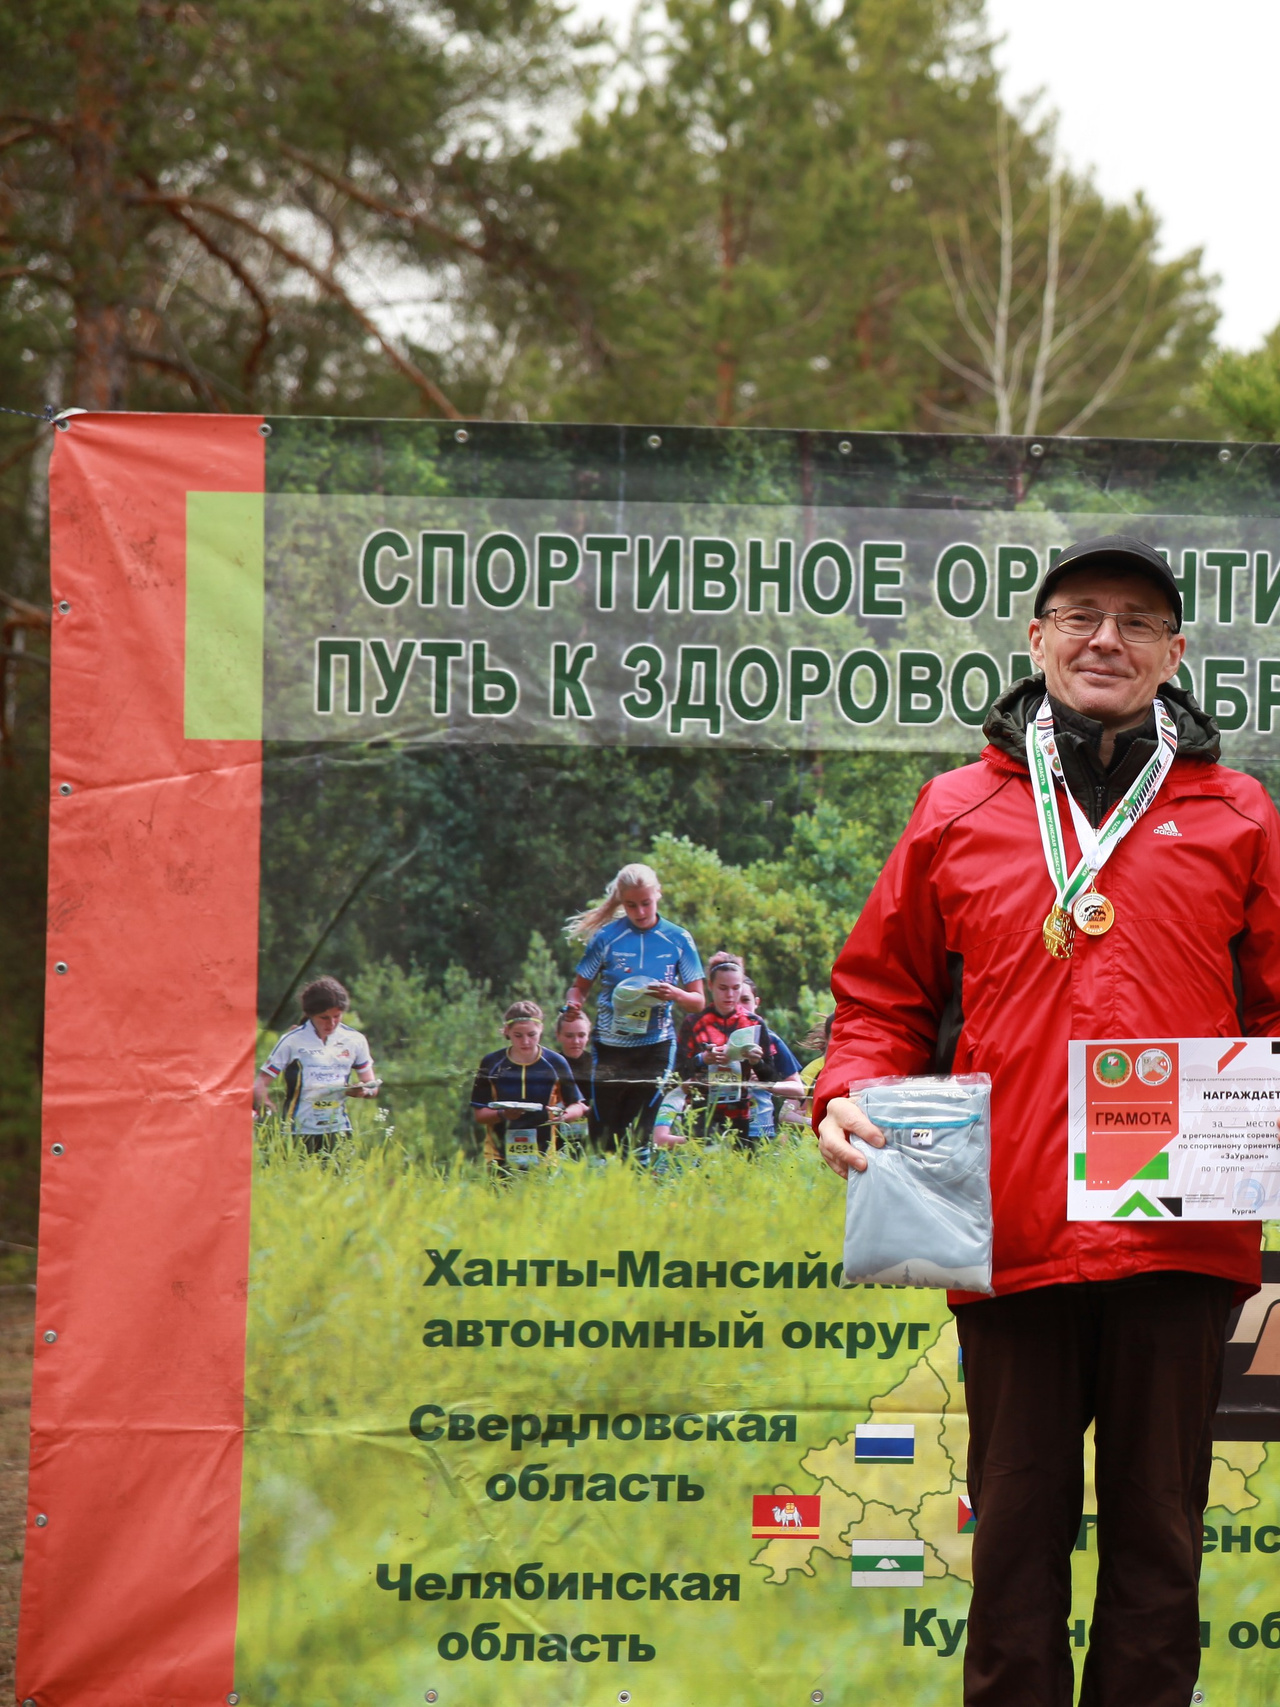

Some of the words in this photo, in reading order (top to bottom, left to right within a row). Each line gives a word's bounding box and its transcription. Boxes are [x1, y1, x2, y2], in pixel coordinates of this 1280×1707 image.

[361, 529, 905, 617] СПОРТИВНОЕ
[315, 639, 520, 717] ПУТЬ
[551, 642, 594, 718] К
[621, 643, 1047, 736] ЗДОРОВО
[1153, 828, 1183, 837] adidas
[1095, 1111, 1172, 1126] ГРАМОТА
[1188, 1132, 1245, 1141] региональных
[1246, 1132, 1279, 1140] соревно
[1245, 1120, 1276, 1128] место
[1189, 1142, 1242, 1151] спортивному
[1201, 1165, 1212, 1173] по
[1215, 1165, 1245, 1174] группе
[422, 1249, 941, 1290] Ханты-Мансий
[422, 1310, 764, 1350] автономный
[780, 1320, 930, 1359] округ
[408, 1404, 798, 1451] Свердловская
[485, 1463, 705, 1502] область
[376, 1562, 741, 1602] Челябинская
[437, 1623, 657, 1663] область
